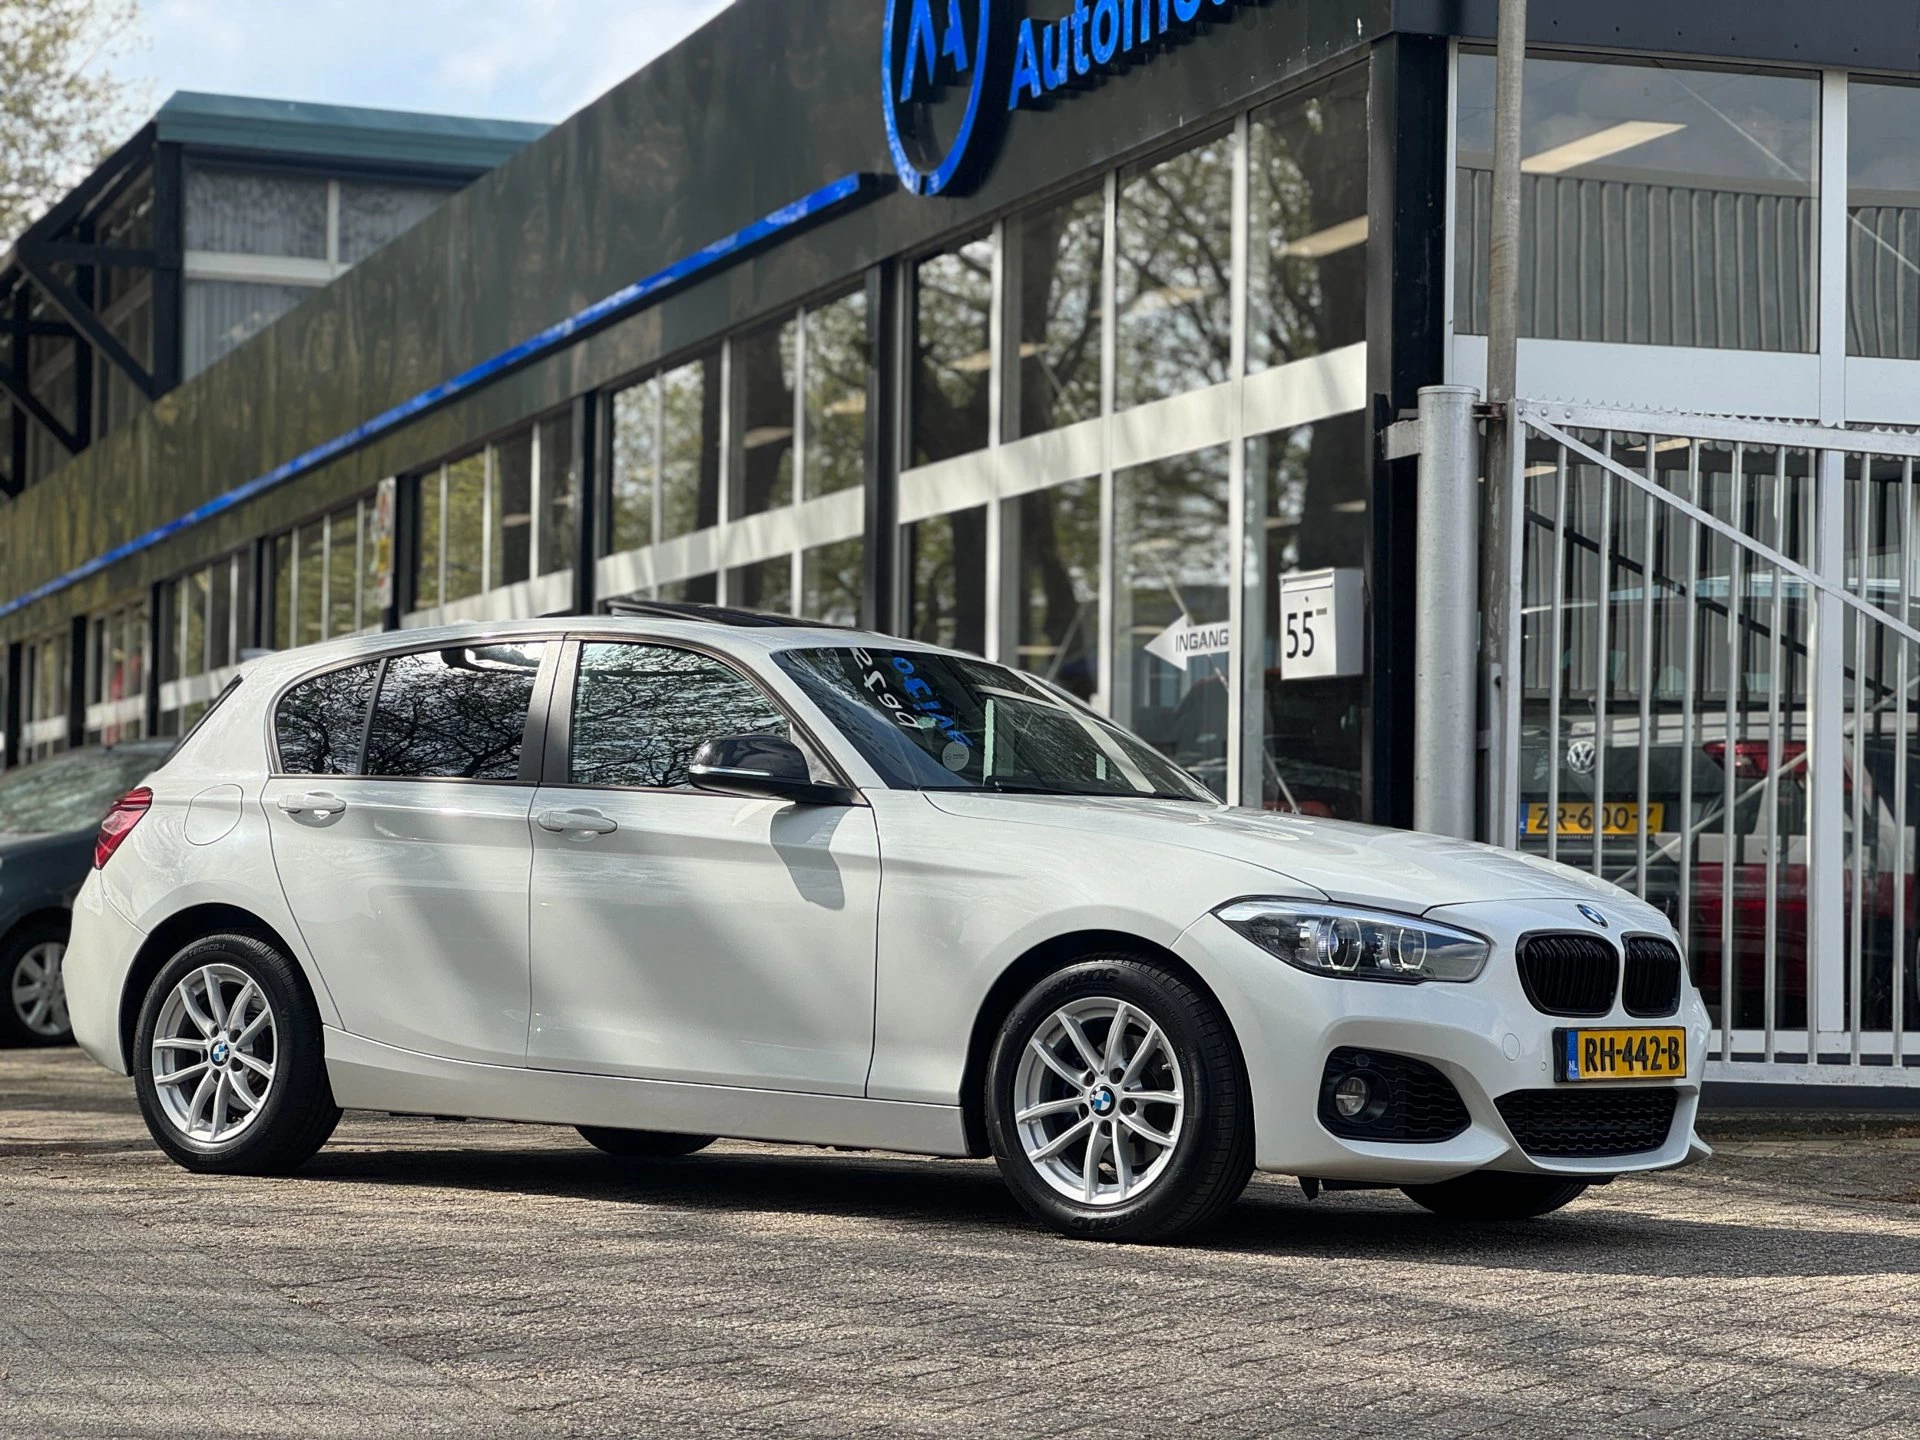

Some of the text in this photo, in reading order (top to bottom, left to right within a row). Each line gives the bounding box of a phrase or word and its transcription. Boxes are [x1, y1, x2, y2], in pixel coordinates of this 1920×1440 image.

[1008, 0, 1225, 110] Autom
[1175, 629, 1229, 652] INGANG
[1286, 610, 1315, 659] 55
[1568, 1060, 1578, 1071] NL
[1584, 1035, 1681, 1073] RH-442-B
